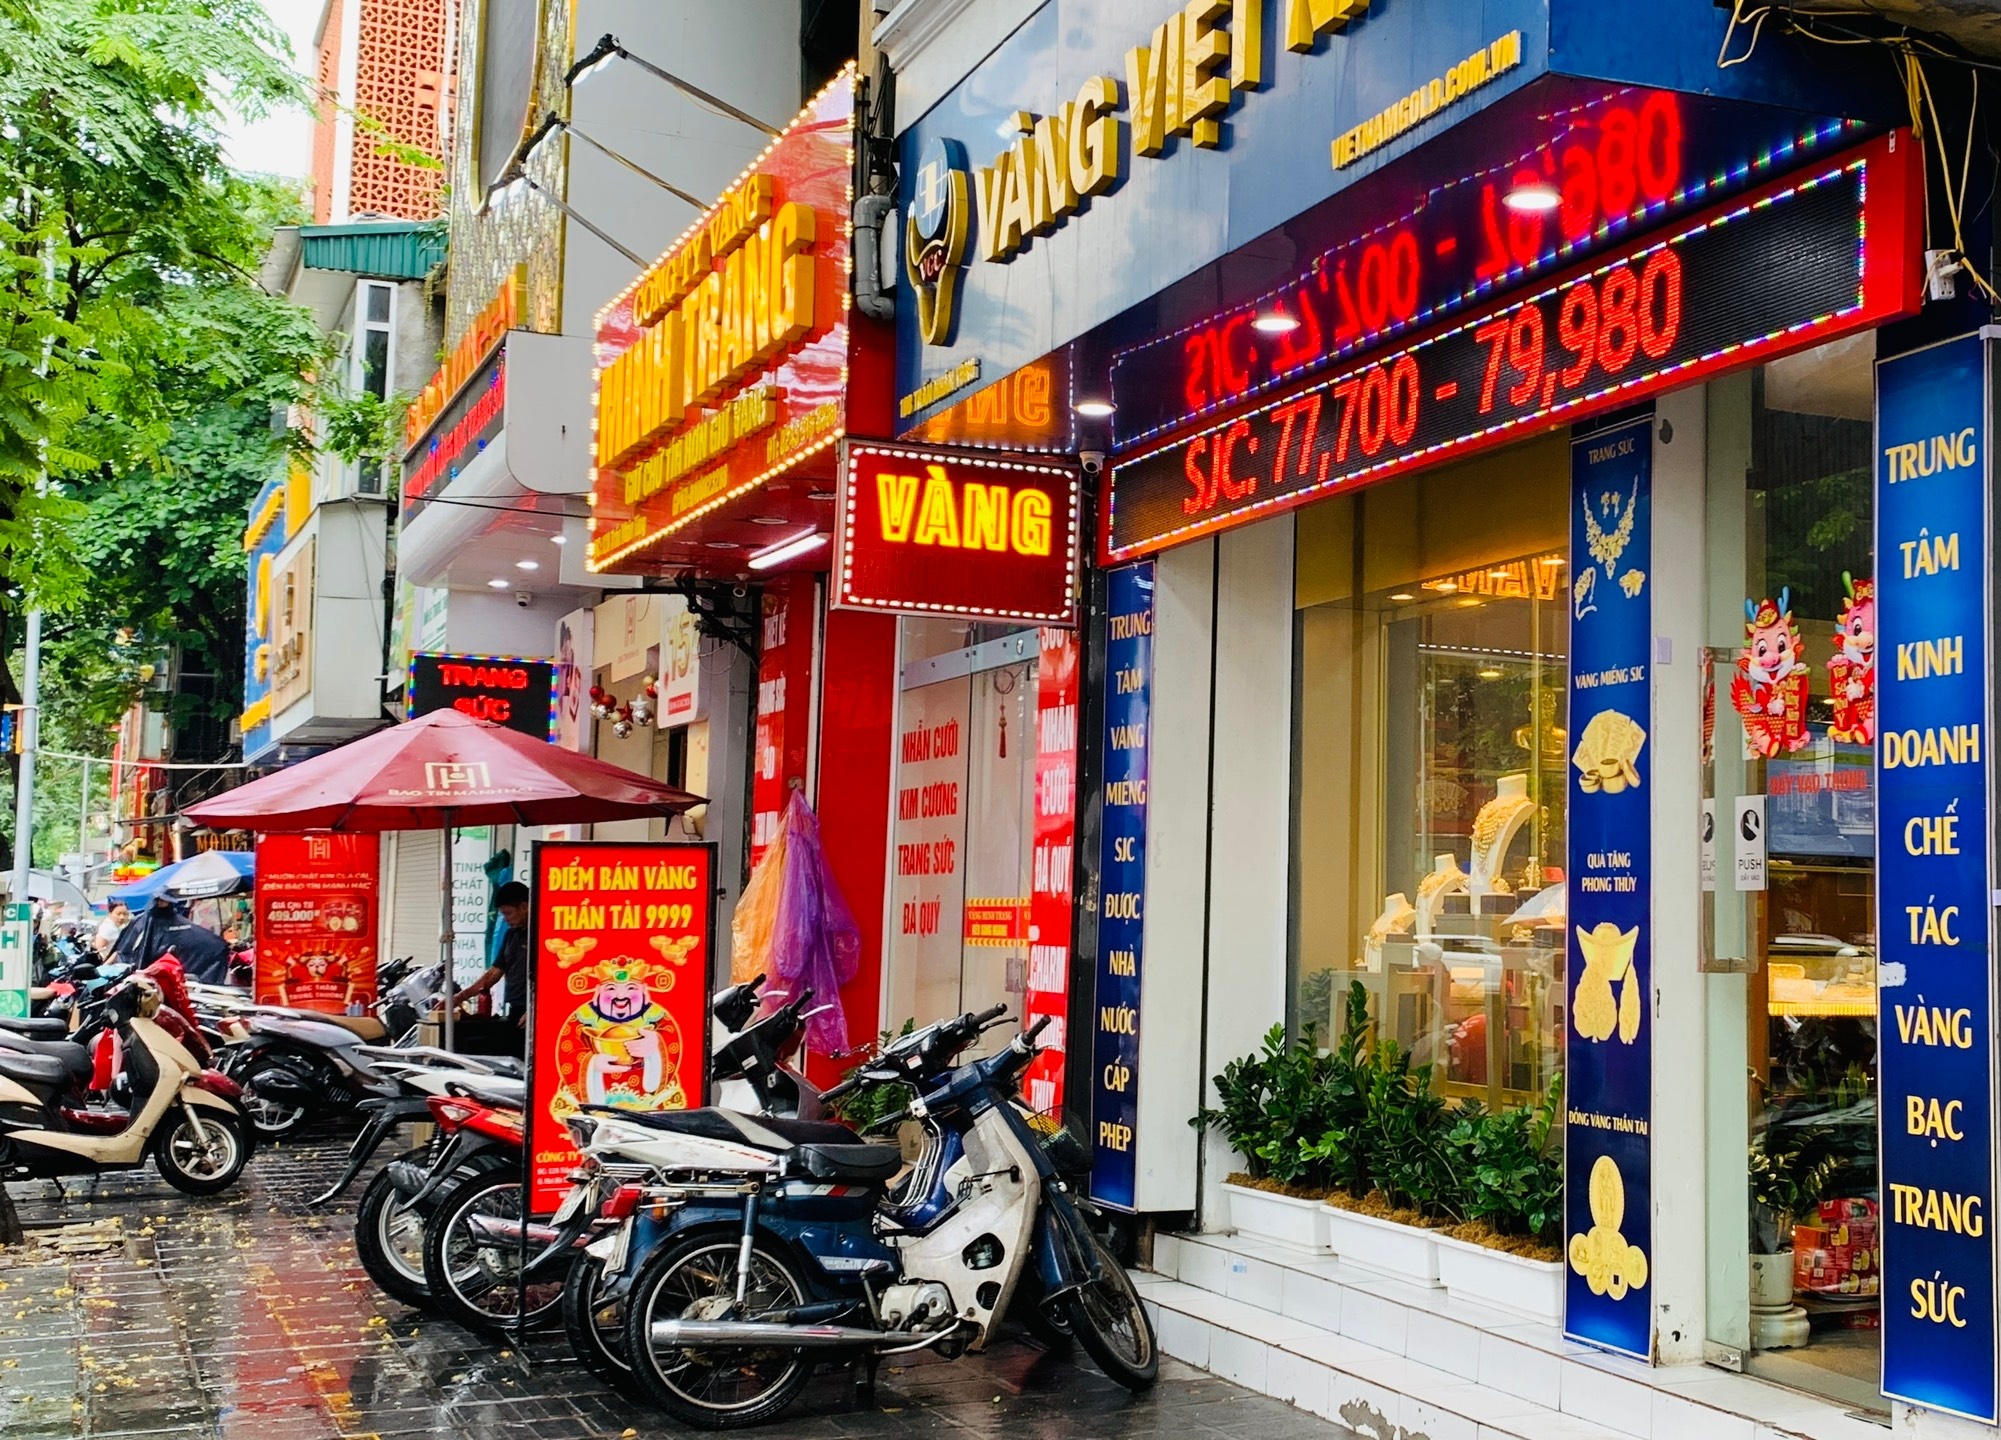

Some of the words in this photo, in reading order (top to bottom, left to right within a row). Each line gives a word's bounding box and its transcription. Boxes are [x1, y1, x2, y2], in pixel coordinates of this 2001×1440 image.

[1330, 29, 1522, 171] VIETNAMGOLD.COM.VN
[974, 74, 1118, 262] VÀNG
[680, 229, 713, 287] TY
[708, 173, 773, 257] VÀNG
[598, 309, 685, 470] MINH
[681, 201, 816, 408] TRANG
[1272, 354, 1421, 486] 77,700
[1475, 248, 1682, 414] 79,980
[1588, 443, 1617, 465] TRANG
[1618, 437, 1636, 458] SỨC
[1884, 427, 1977, 484] TRUNG
[876, 465, 1053, 557] VÀNG
[1899, 527, 1960, 580] TÂM
[1110, 612, 1151, 641] TRUNG
[437, 664, 528, 690] TRANG
[1115, 662, 1144, 695] TÂM
[1575, 669, 1599, 690] VÀNG
[1600, 662, 1629, 687] MIẾNG
[1897, 635, 1964, 681] KINH
[902, 719, 931, 764] NHẪN
[933, 716, 959, 760] CƯỚI
[1041, 690, 1076, 754] NHẪN
[1110, 718, 1145, 750] VÀNG
[1883, 723, 1980, 770] DOANH
[899, 786, 919, 821] KIM
[921, 780, 958, 819] CƯƠNG
[1040, 759, 1071, 816] CƯỚI
[1105, 772, 1146, 807] MIẾNG
[1904, 797, 1960, 856] CHẾ
[454, 862, 483, 873] TINH
[548, 856, 595, 892] ĐIỂM
[599, 860, 640, 891] BÁN
[643, 859, 698, 891] VÀNG
[898, 844, 930, 876] TRANG
[933, 831, 955, 875] SỨC
[1034, 838, 1049, 893] ĐÁ
[1050, 835, 1072, 899] QUÝ
[1587, 848, 1606, 870] QUÀ
[1606, 848, 1631, 872] TẶNG
[1738, 858, 1763, 870] PUSH
[451, 877, 484, 890] CHẤT
[1581, 875, 1612, 893] PHONG
[1613, 870, 1638, 893] THỦY
[609, 899, 641, 930] TÀI
[645, 903, 693, 930] 9999
[902, 894, 917, 936] ĐÁ
[919, 892, 941, 938] QUÝ
[1104, 891, 1141, 925] ĐƯỢC
[1905, 894, 1960, 946] TÁC
[453, 936, 476, 950] NHÀ
[1109, 944, 1136, 977] NHÀ
[1029, 944, 1067, 994] CHARM
[1101, 1001, 1137, 1036] NƯỚC
[1894, 994, 1973, 1050] VÀNG
[1104, 1055, 1130, 1092] CẤP
[1099, 1118, 1132, 1153] PHÉP
[1590, 1108, 1612, 1130] VÀNG
[1634, 1114, 1649, 1136] TÀI
[1906, 1094, 1964, 1149] BẠC
[535, 1149, 565, 1164] CÔNG
[1889, 1182, 1984, 1238] TRANG
[1910, 1270, 1968, 1328] SỨC
